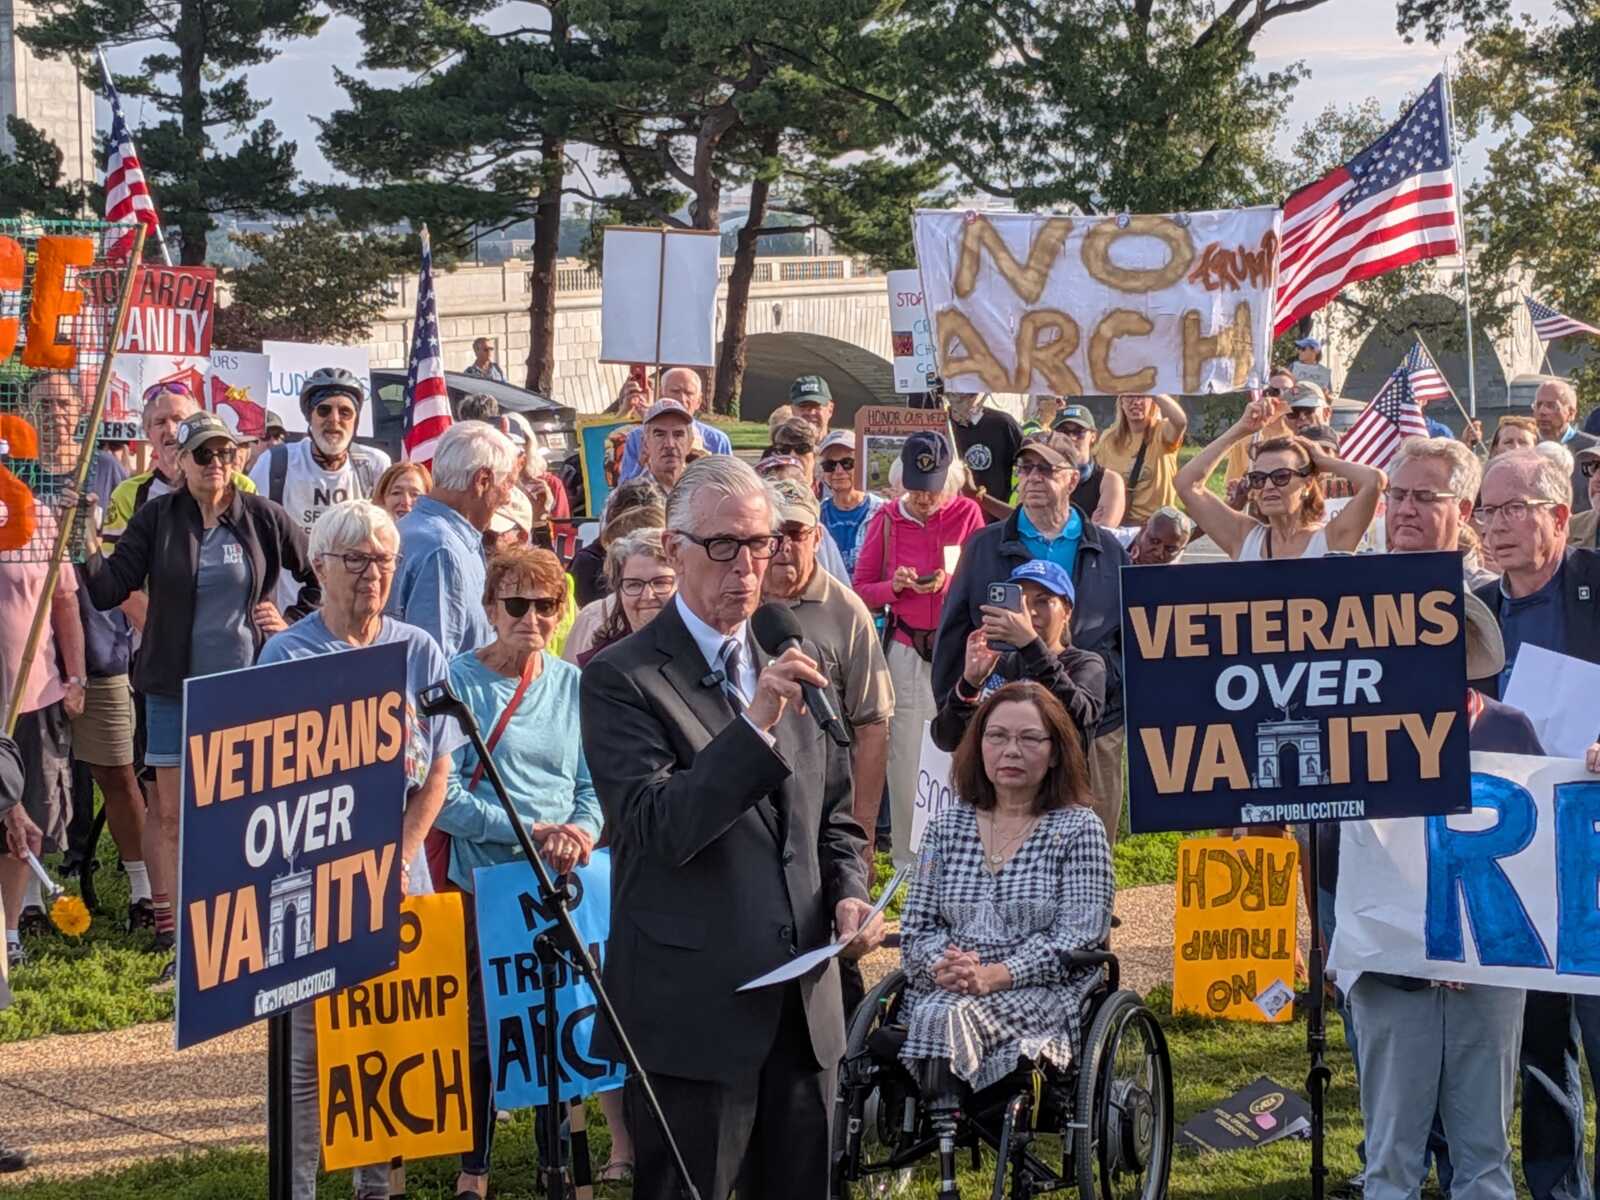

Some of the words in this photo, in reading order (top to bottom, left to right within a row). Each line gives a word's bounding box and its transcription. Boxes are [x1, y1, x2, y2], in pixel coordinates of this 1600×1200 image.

[139, 270, 211, 310] ARCH
[955, 215, 1195, 303] NO
[936, 300, 1254, 396] ARCH
[314, 487, 348, 506] NO
[1128, 590, 1459, 660] VETERANS
[1215, 658, 1383, 711] OVER
[189, 691, 402, 807] VETERANS
[245, 784, 355, 868] OVER
[1182, 848, 1296, 911] ARCH
[400, 911, 422, 954] O
[1182, 928, 1290, 960] TRUMP
[327, 975, 459, 1030] TRUMP
[1207, 970, 1257, 1012] NO
[496, 1004, 625, 1091] ARC
[326, 1048, 467, 1146] ARCH
